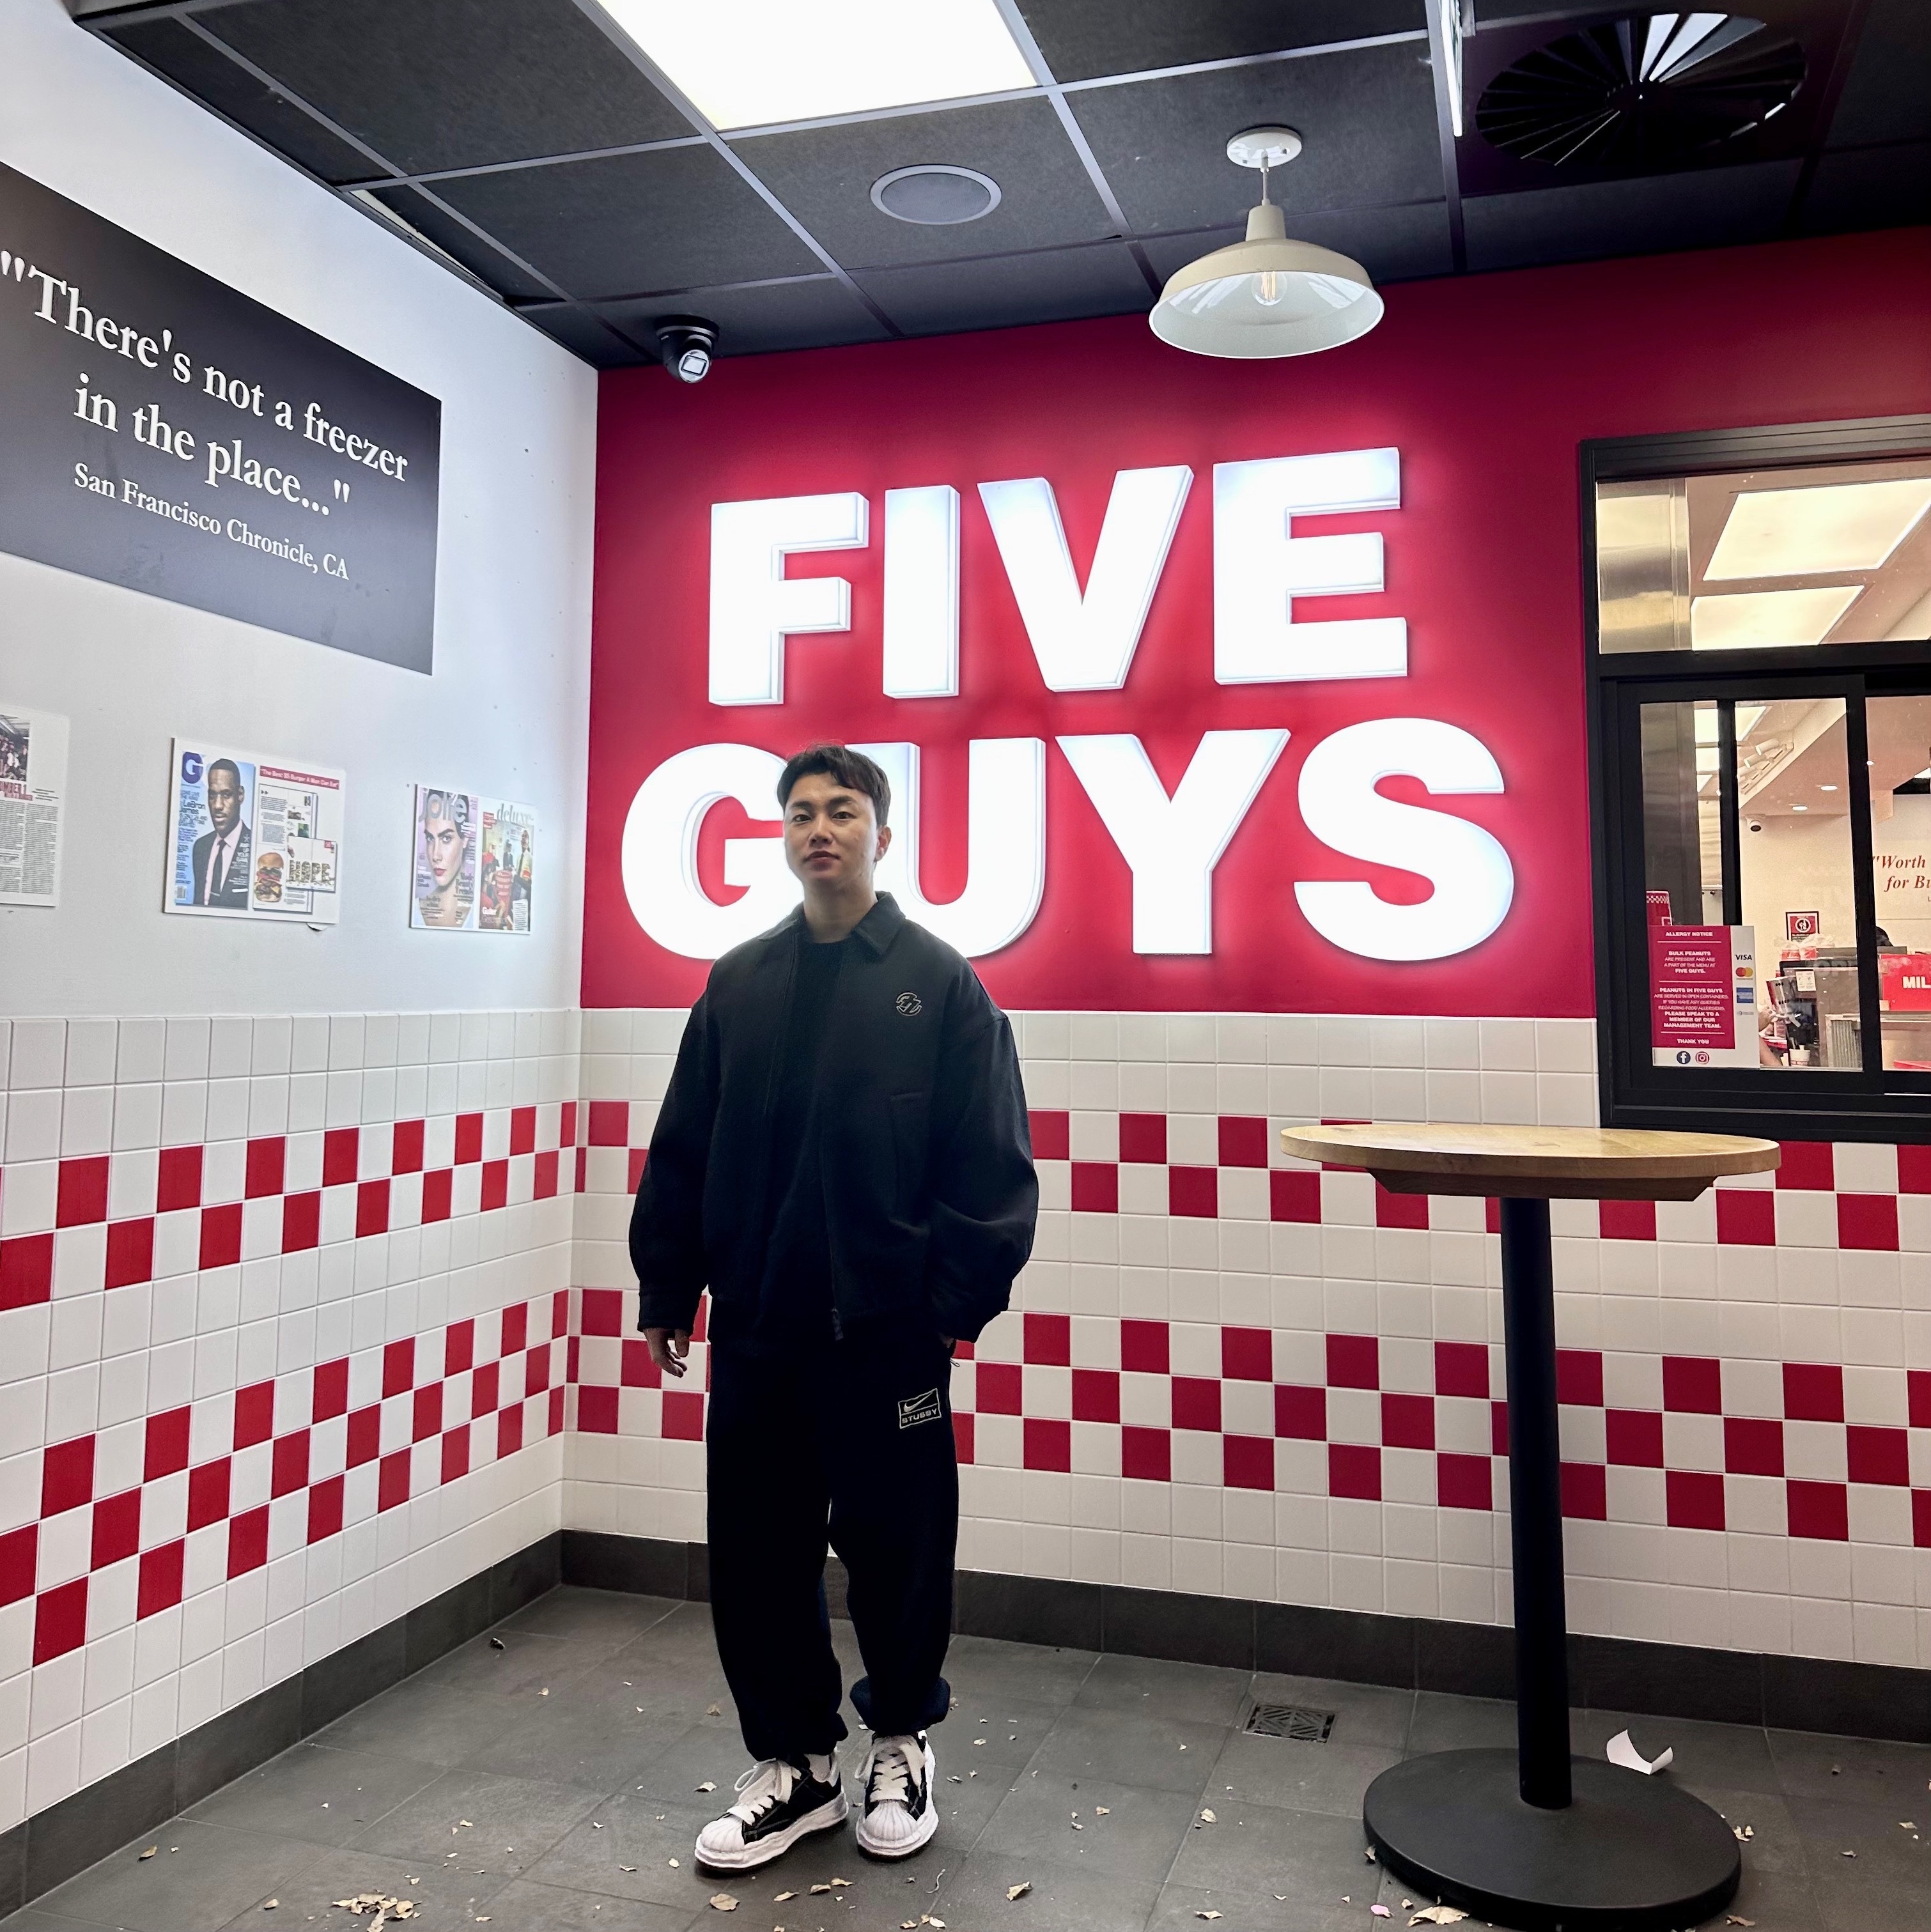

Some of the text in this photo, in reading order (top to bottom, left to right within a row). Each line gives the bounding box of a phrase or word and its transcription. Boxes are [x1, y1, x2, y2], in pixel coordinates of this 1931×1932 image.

[1, 251, 408, 482] "There's not a freezer
[74, 373, 118, 432] in
[132, 404, 195, 460] the
[74, 463, 349, 580] San Francisco Chronicle, CA
[708, 446, 1408, 706] FIVE
[620, 717, 1514, 961] GUYS
[1883, 875, 1909, 893] for
[902, 1408, 937, 1424] STUSSY
